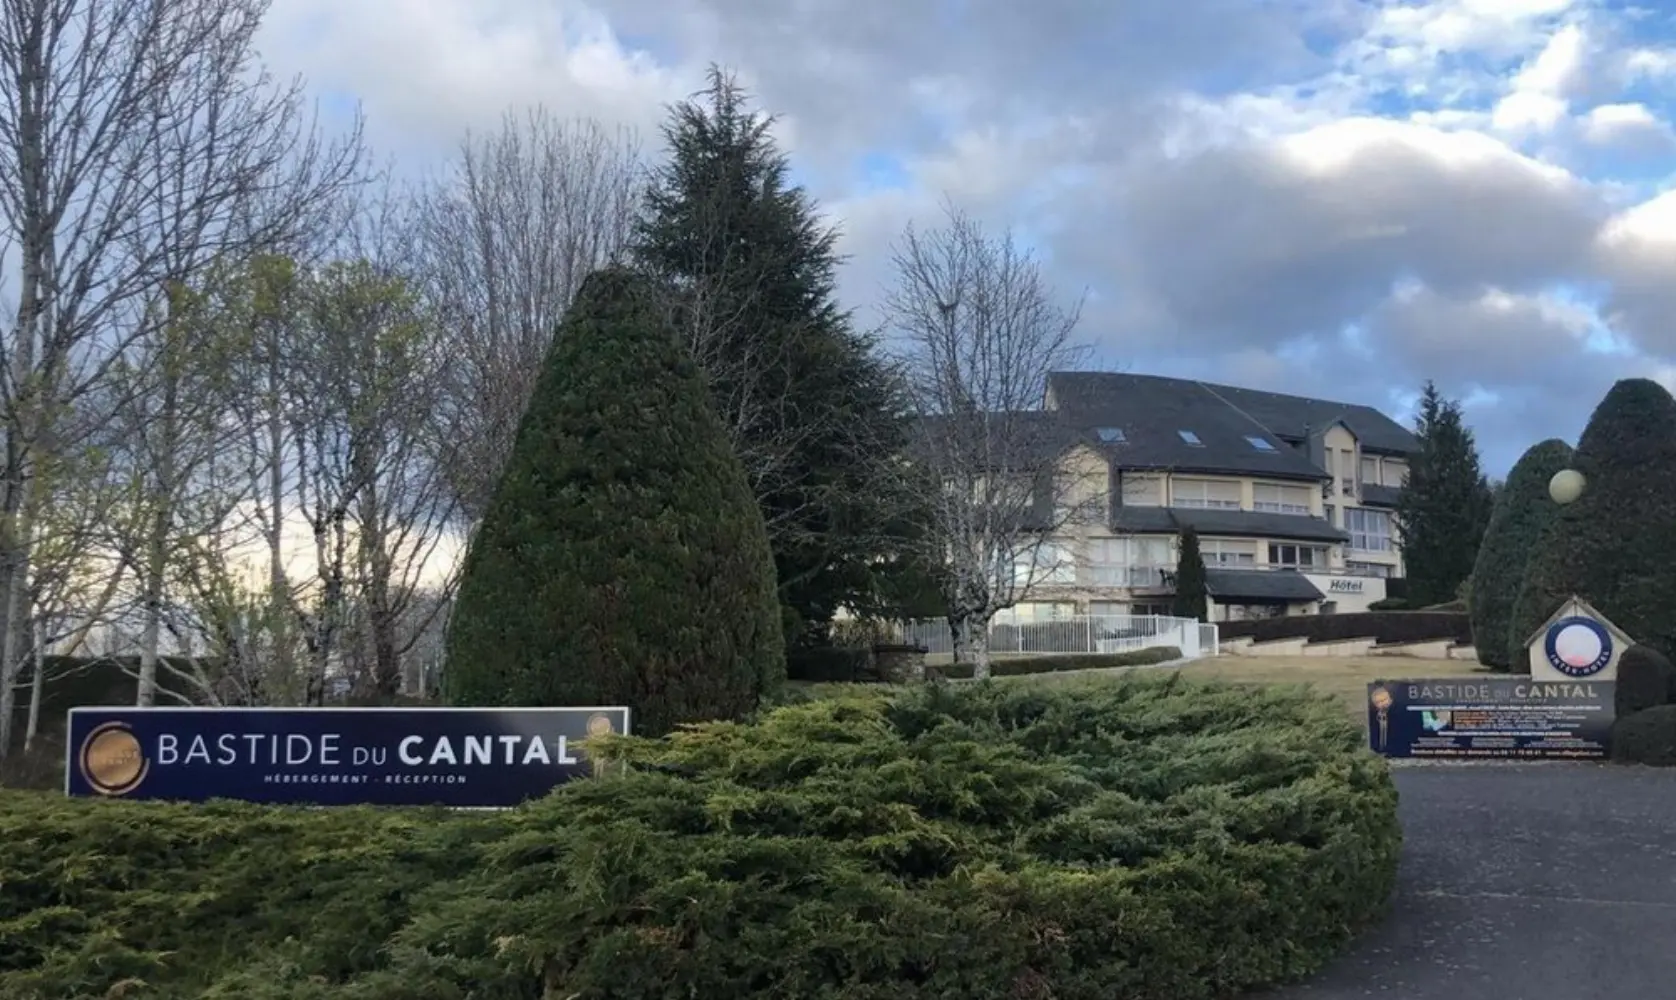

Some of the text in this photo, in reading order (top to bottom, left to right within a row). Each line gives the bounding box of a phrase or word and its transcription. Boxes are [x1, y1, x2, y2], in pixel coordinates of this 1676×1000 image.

[1330, 579, 1363, 590] Hôtel
[1408, 685, 1489, 699] BASTIDE
[1515, 684, 1598, 698] CANTAL
[157, 733, 341, 766] BASTIDE
[352, 745, 387, 766] DU
[398, 734, 578, 766] CANTAL
[264, 773, 369, 784] HÉBERGEMENT
[384, 773, 468, 785] RÉCEPTION
